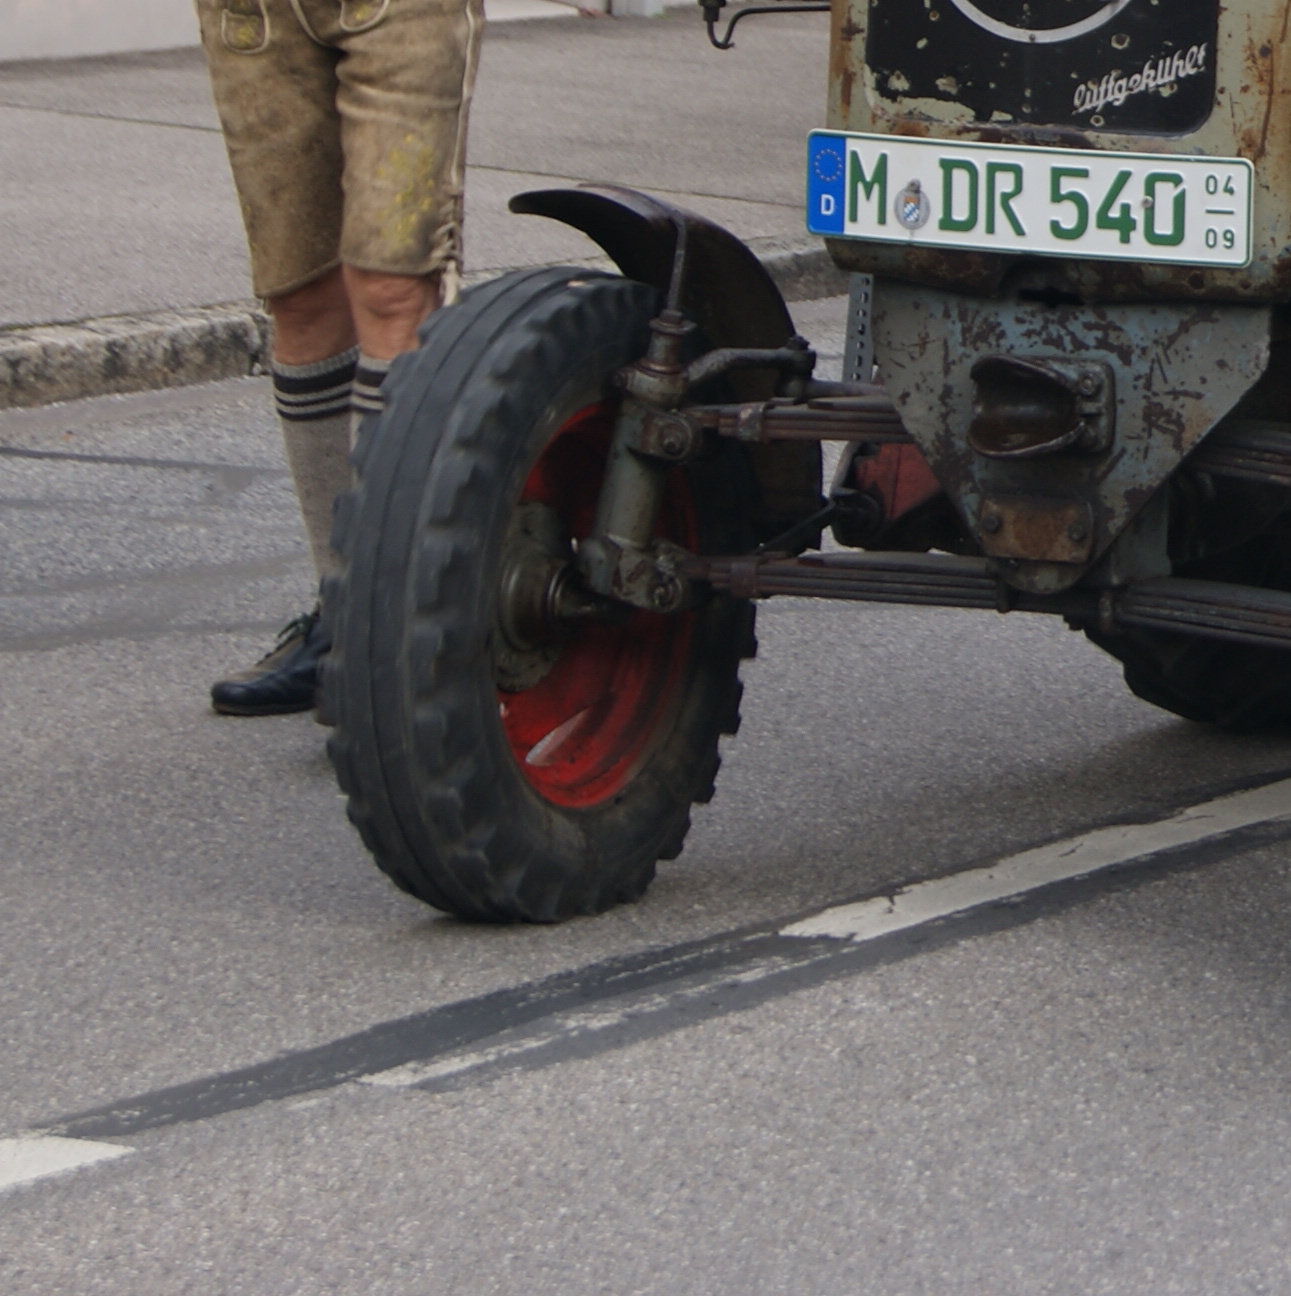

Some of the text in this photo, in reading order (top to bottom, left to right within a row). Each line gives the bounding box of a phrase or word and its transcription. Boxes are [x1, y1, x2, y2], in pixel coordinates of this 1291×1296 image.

[1204, 174, 1235, 197] 04
[820, 194, 836, 217] D
[848, 149, 1187, 246] M DR 540
[1204, 227, 1236, 250] 09
